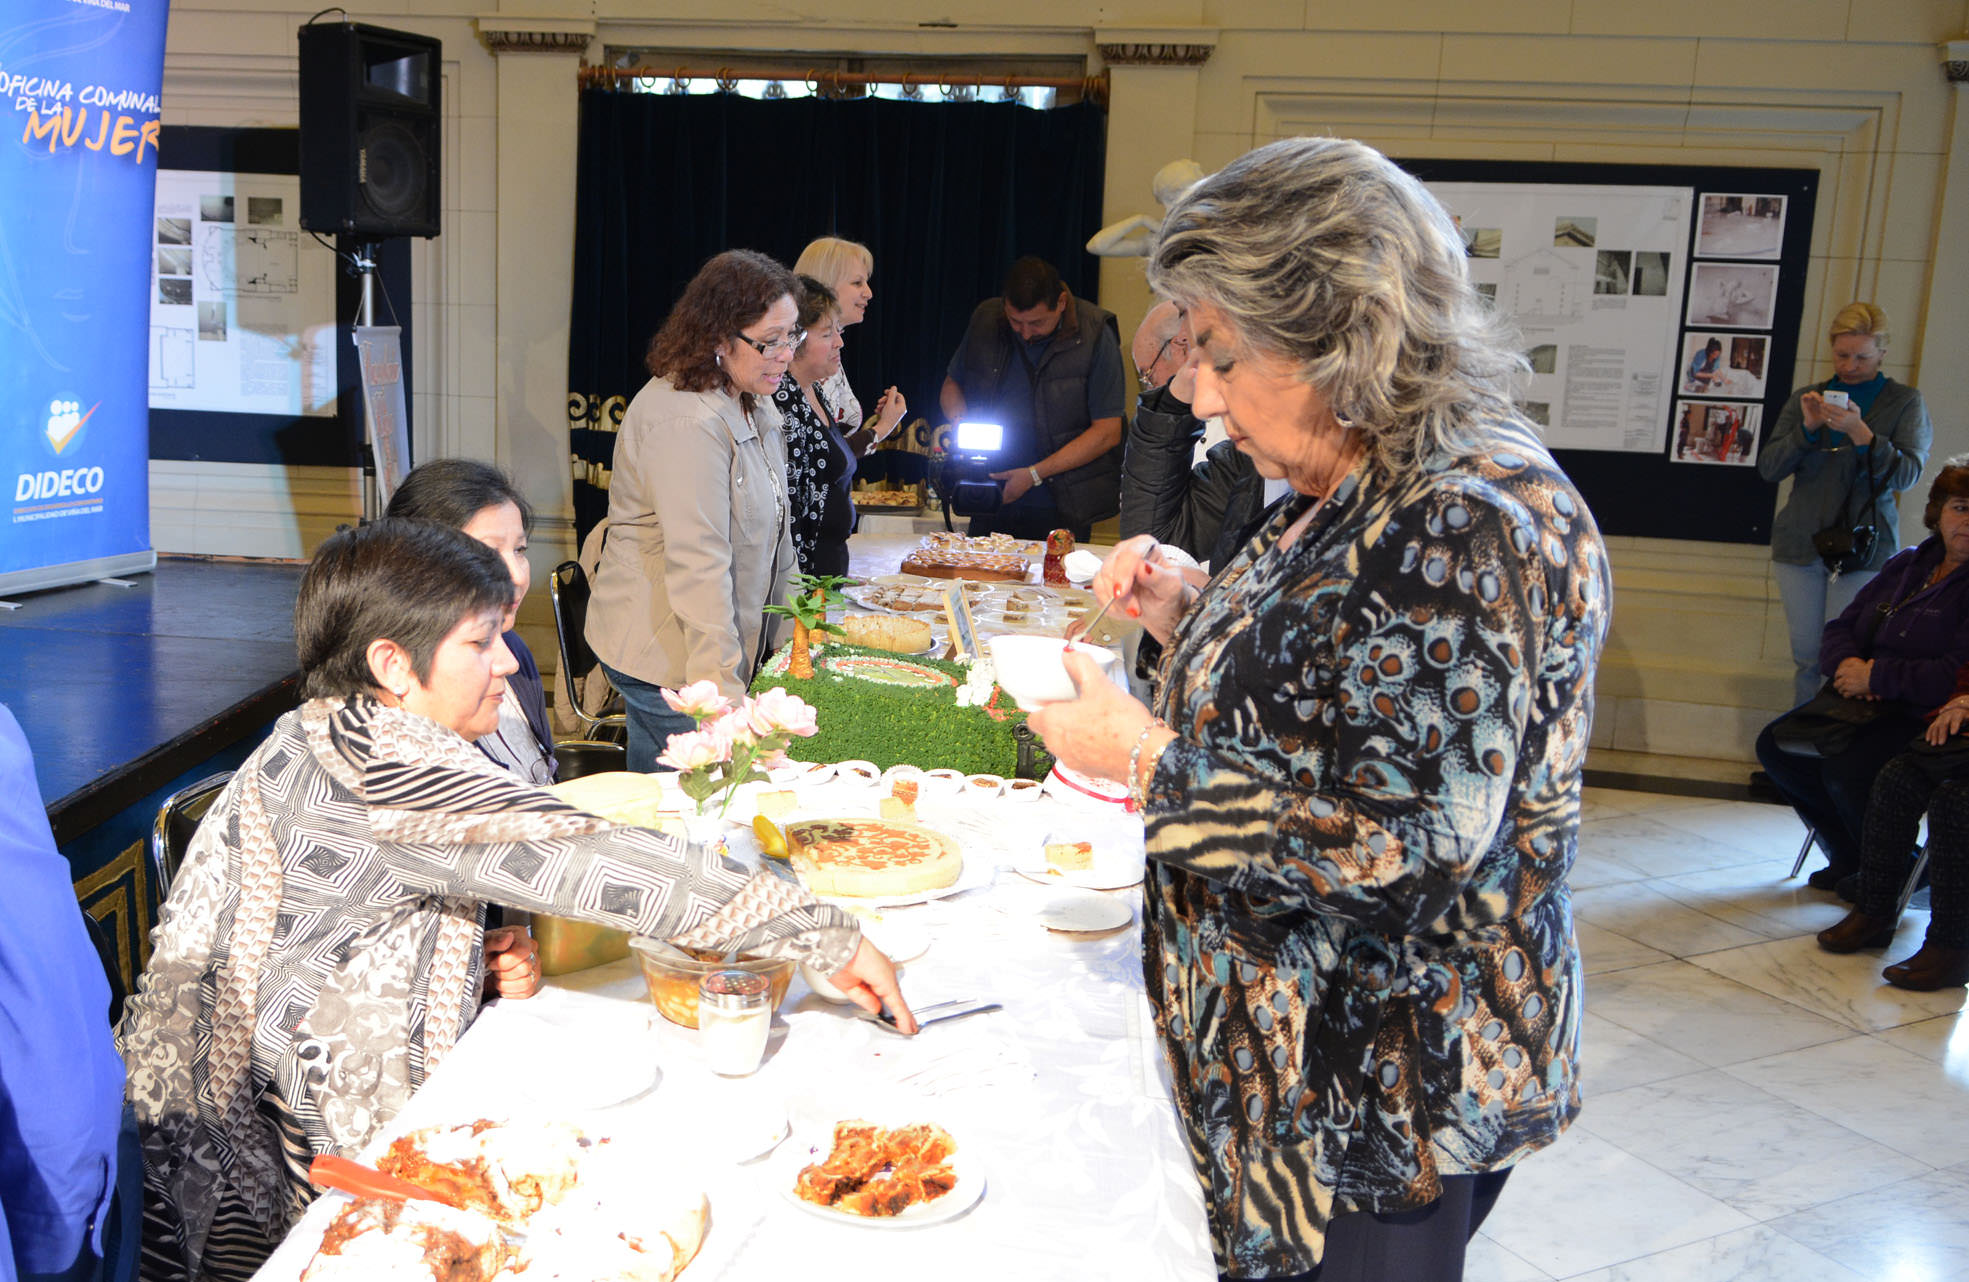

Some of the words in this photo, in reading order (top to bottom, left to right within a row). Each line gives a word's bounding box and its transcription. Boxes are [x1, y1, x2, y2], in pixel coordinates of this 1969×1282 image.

[0, 71, 73, 101] OFICINA
[79, 85, 161, 113] COMUNAL
[15, 96, 38, 111] DE
[41, 101, 63, 115] LA
[22, 106, 160, 165] MUJER
[15, 466, 104, 502] DIDECO
